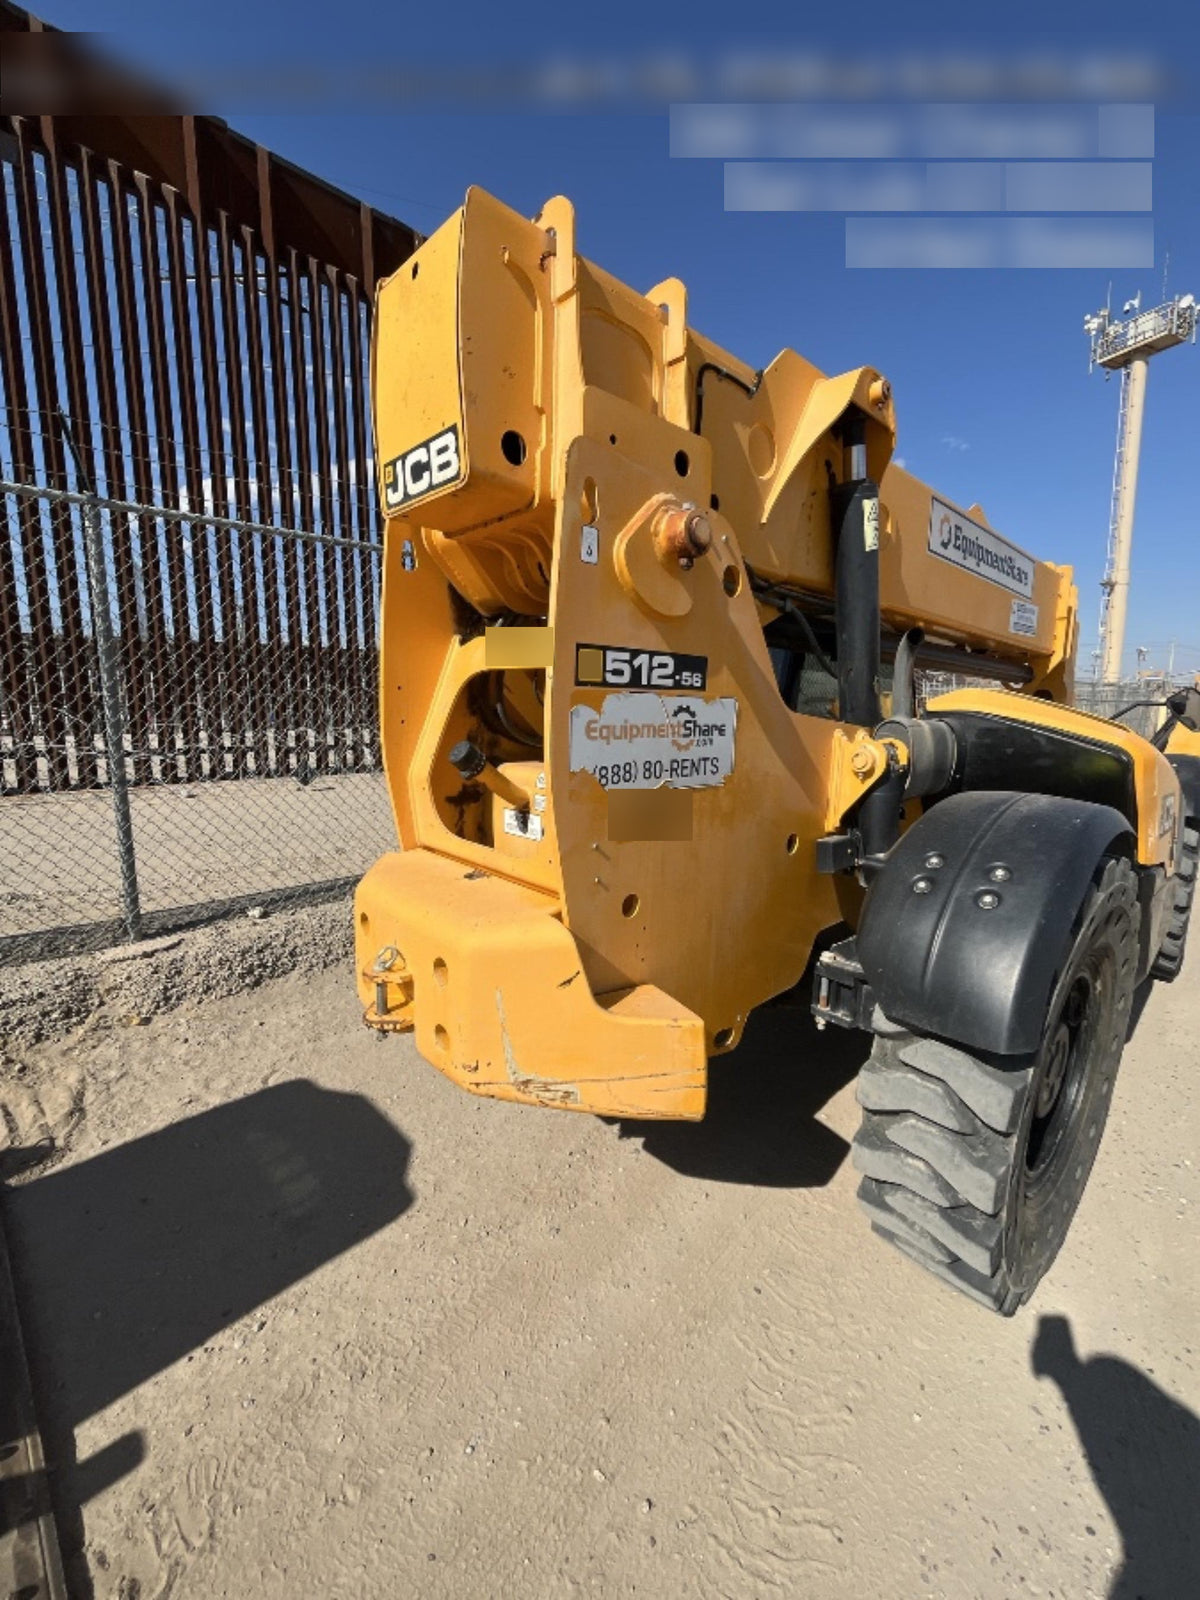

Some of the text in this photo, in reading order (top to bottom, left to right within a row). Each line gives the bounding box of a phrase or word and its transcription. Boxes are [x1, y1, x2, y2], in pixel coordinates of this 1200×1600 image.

[386, 431, 460, 505] JCB
[585, 719, 726, 745] EquipmentShare
[643, 757, 720, 780] 80-RENTS
